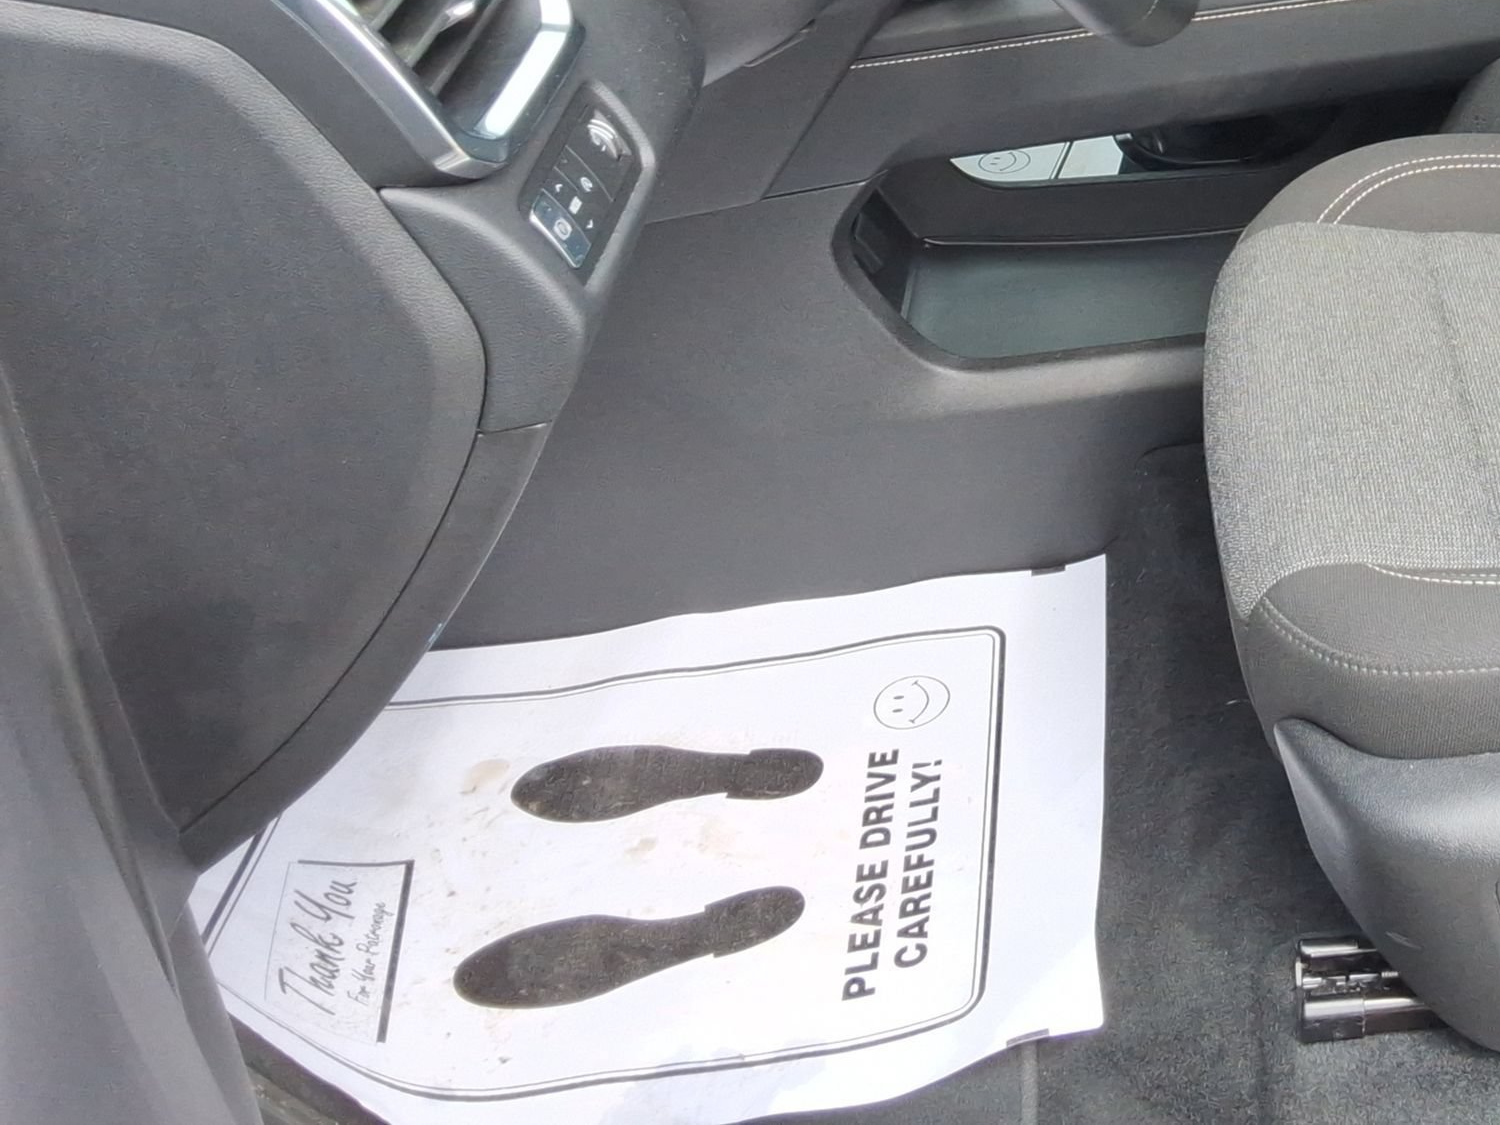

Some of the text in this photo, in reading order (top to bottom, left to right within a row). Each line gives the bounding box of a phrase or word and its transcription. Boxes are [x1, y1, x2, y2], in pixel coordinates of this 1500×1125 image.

[278, 879, 358, 1016] Thank You
[841, 749, 900, 1002] PLEASE DRIVE
[893, 759, 943, 969] CAREFULLY!
[347, 901, 395, 1007] For Your Patronage
